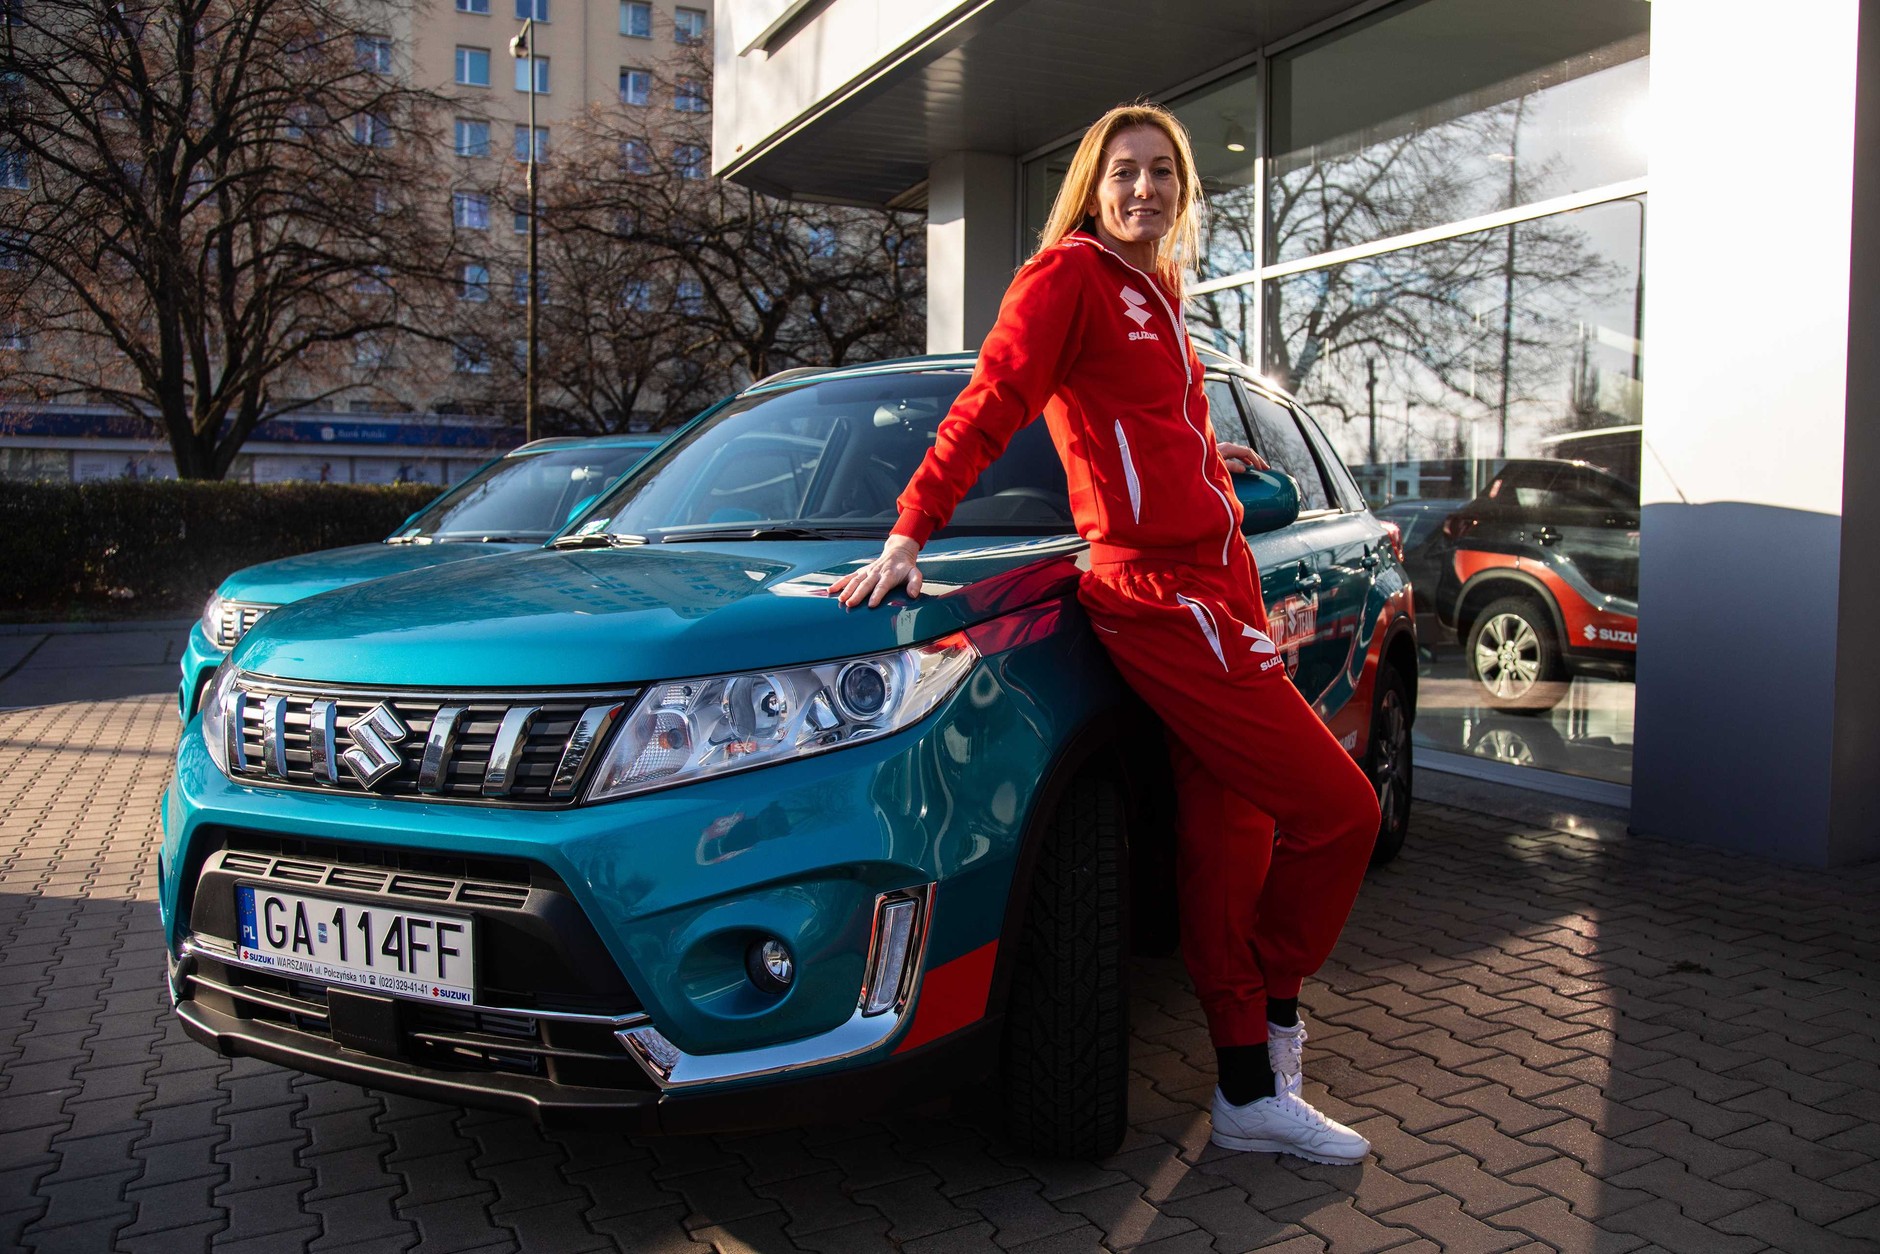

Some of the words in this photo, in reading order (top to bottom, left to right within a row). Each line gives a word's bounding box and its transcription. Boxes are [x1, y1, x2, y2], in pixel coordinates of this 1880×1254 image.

[1598, 628, 1638, 645] SUZU
[242, 925, 256, 940] PL
[264, 896, 316, 957] GA
[332, 906, 465, 979] 114FF
[249, 953, 275, 965] SUZUKI
[276, 956, 314, 974] WARSZAWA
[359, 974, 368, 984] 10
[378, 975, 429, 995] (022)329-41-41
[440, 989, 472, 1002] SUZUKI
